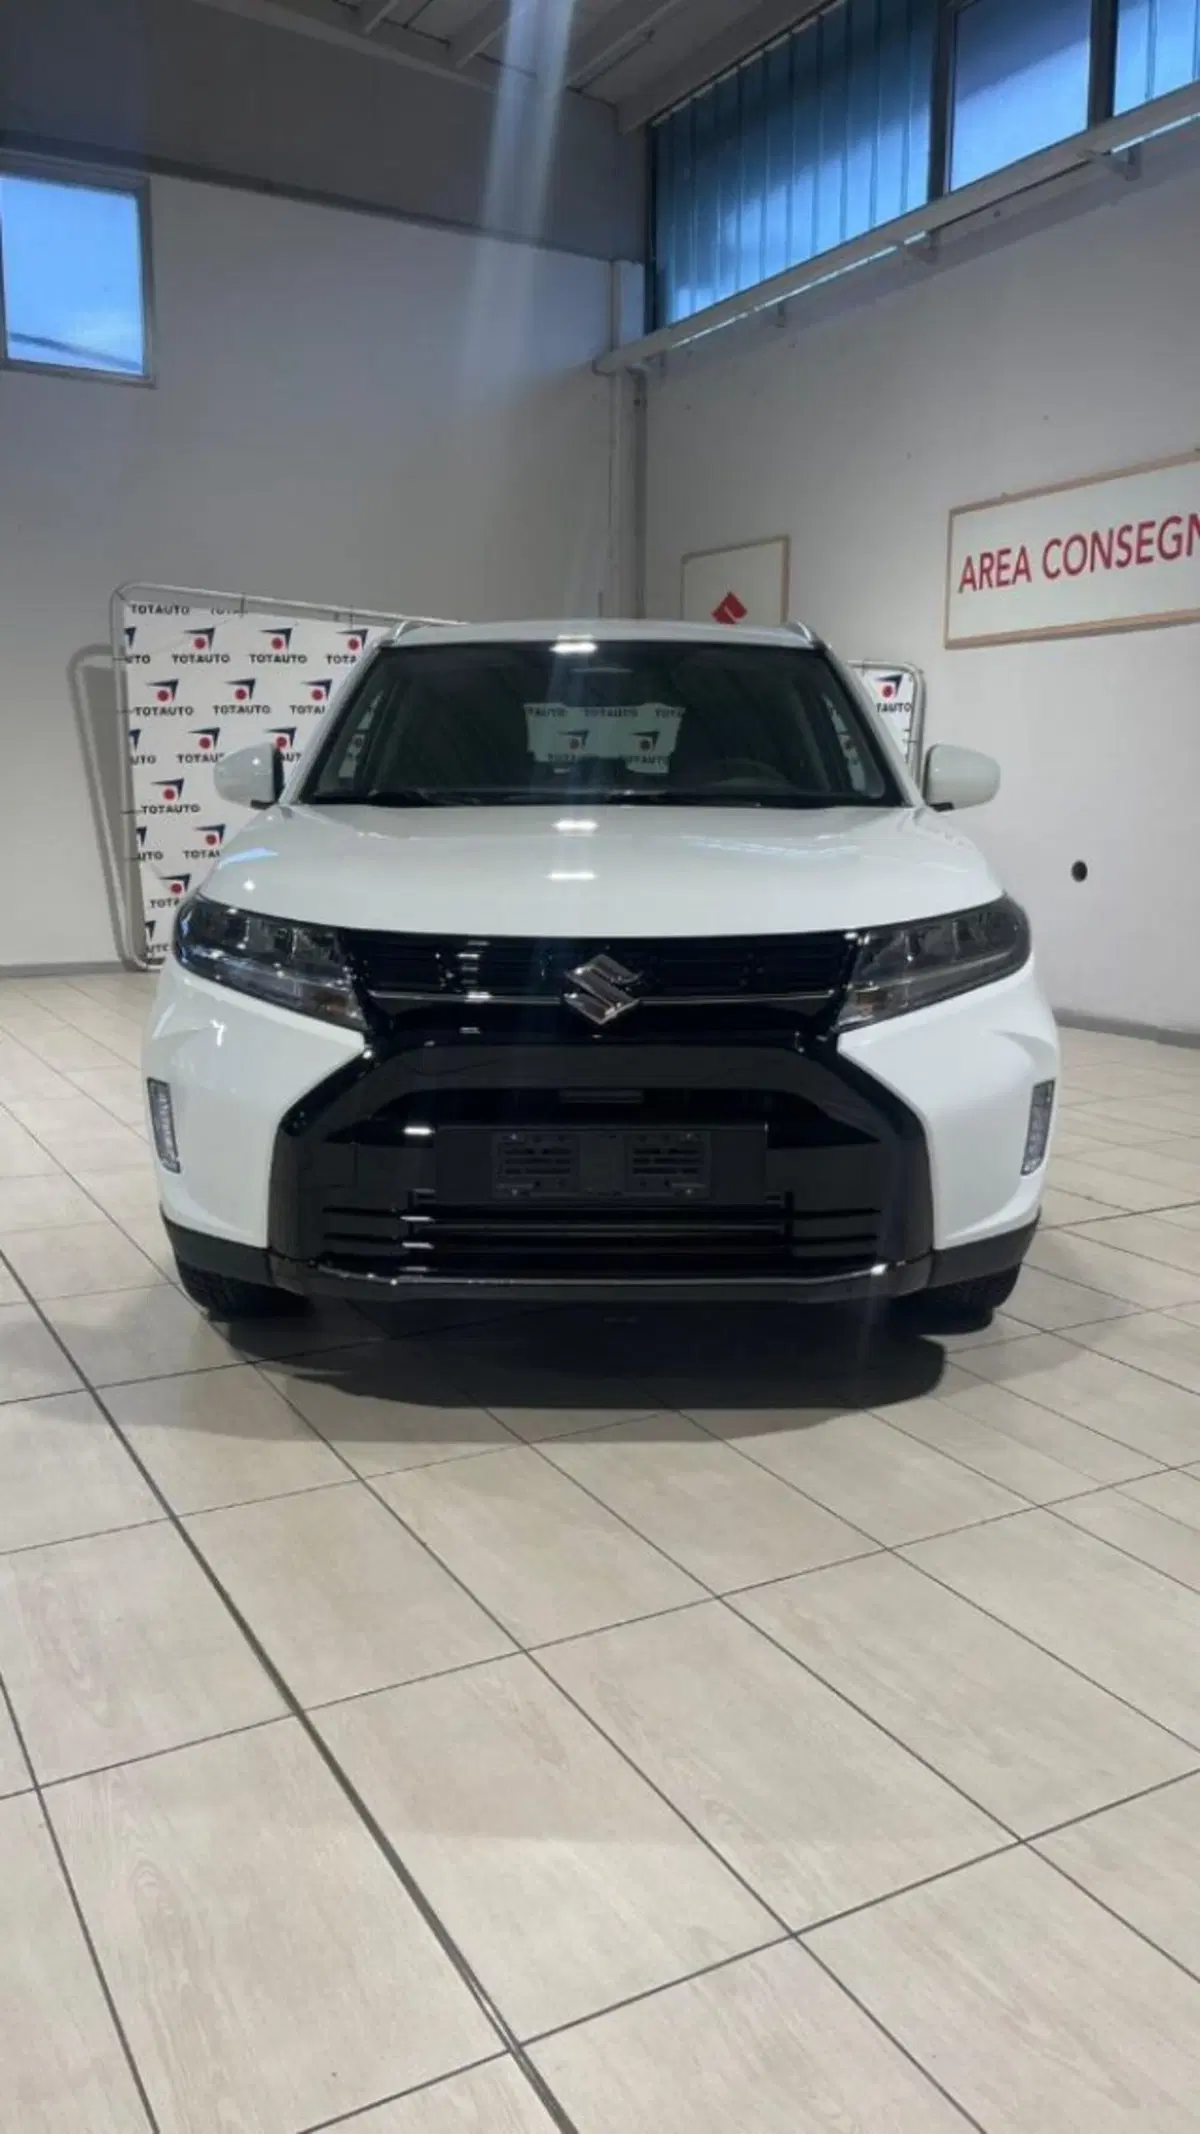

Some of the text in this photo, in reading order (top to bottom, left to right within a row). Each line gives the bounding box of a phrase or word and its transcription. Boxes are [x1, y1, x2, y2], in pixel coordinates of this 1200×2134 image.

[958, 545, 1032, 593] AREA
[131, 604, 190, 615] TOTAUTO
[171, 654, 230, 664] TOTAUTO
[249, 654, 308, 664] TOTAUTO
[135, 706, 194, 716] TOTAUTO
[212, 704, 271, 715] TOTAUTO
[141, 804, 200, 814] TOTAUTO
